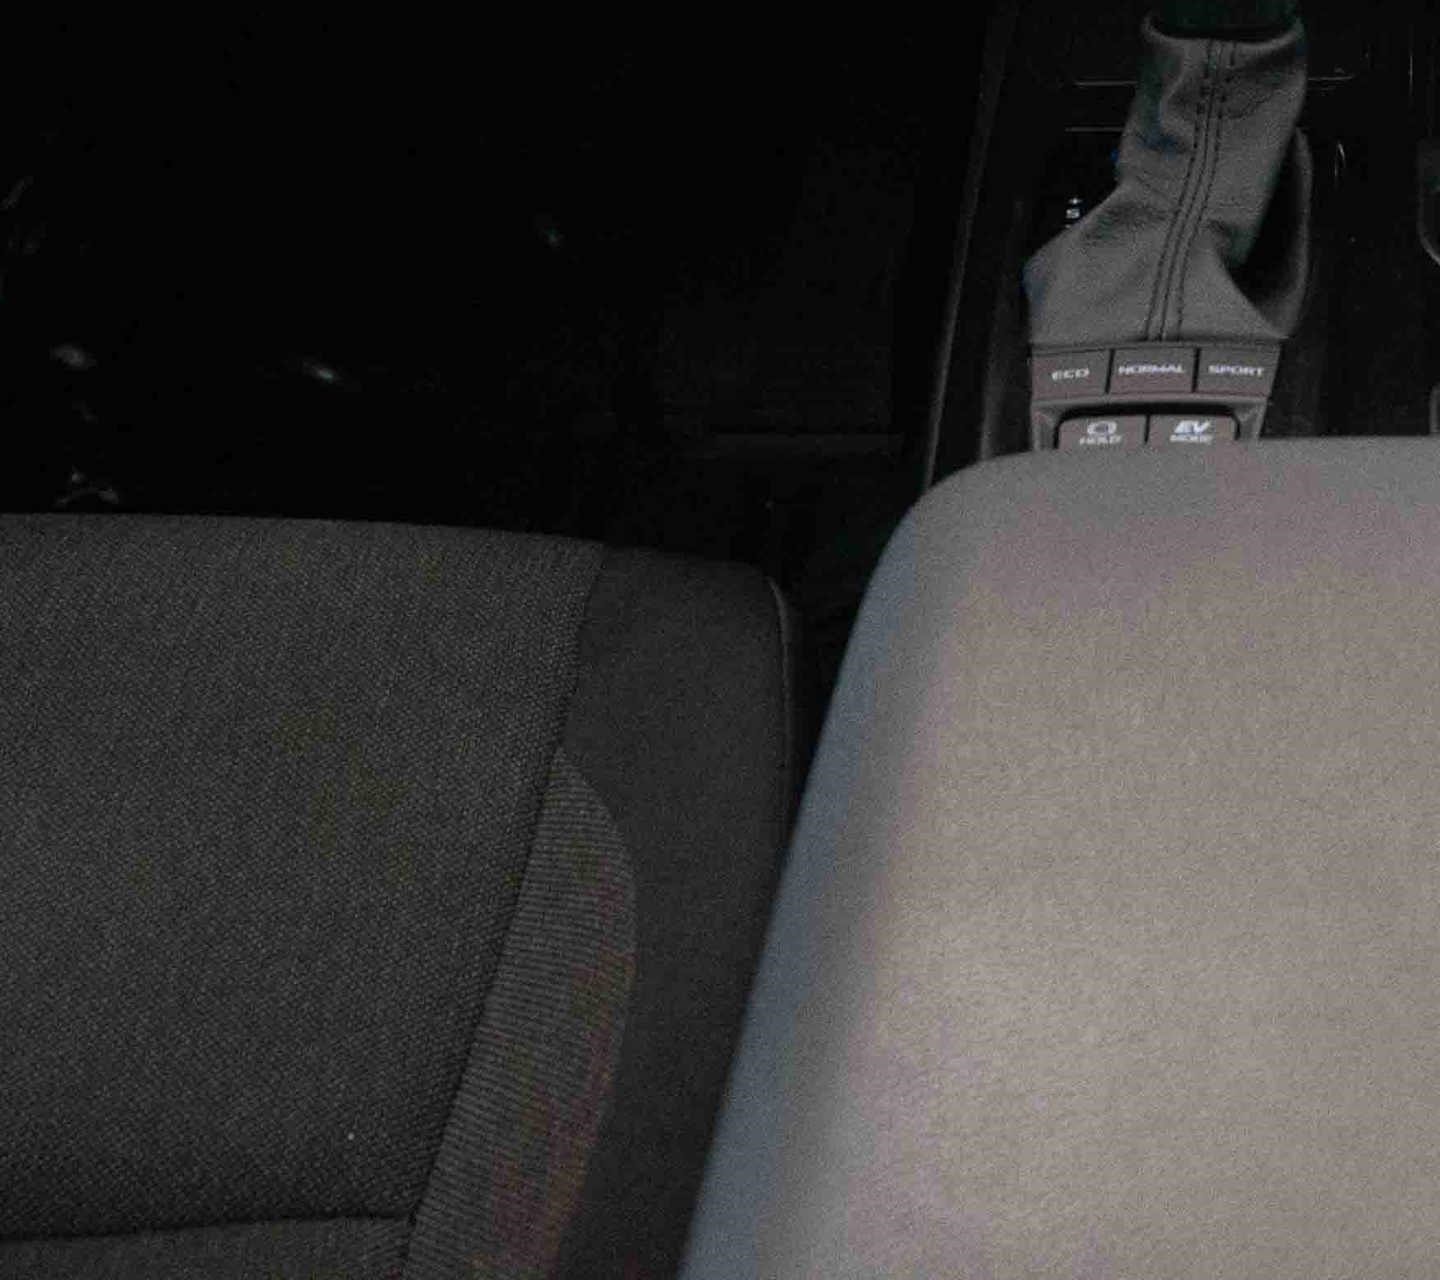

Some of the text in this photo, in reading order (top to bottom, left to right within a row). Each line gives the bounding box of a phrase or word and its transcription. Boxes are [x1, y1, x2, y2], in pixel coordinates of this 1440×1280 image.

[1051, 368, 1090, 381] ECO
[1118, 363, 1184, 375] NORMAL
[1208, 364, 1264, 376] SPORT
